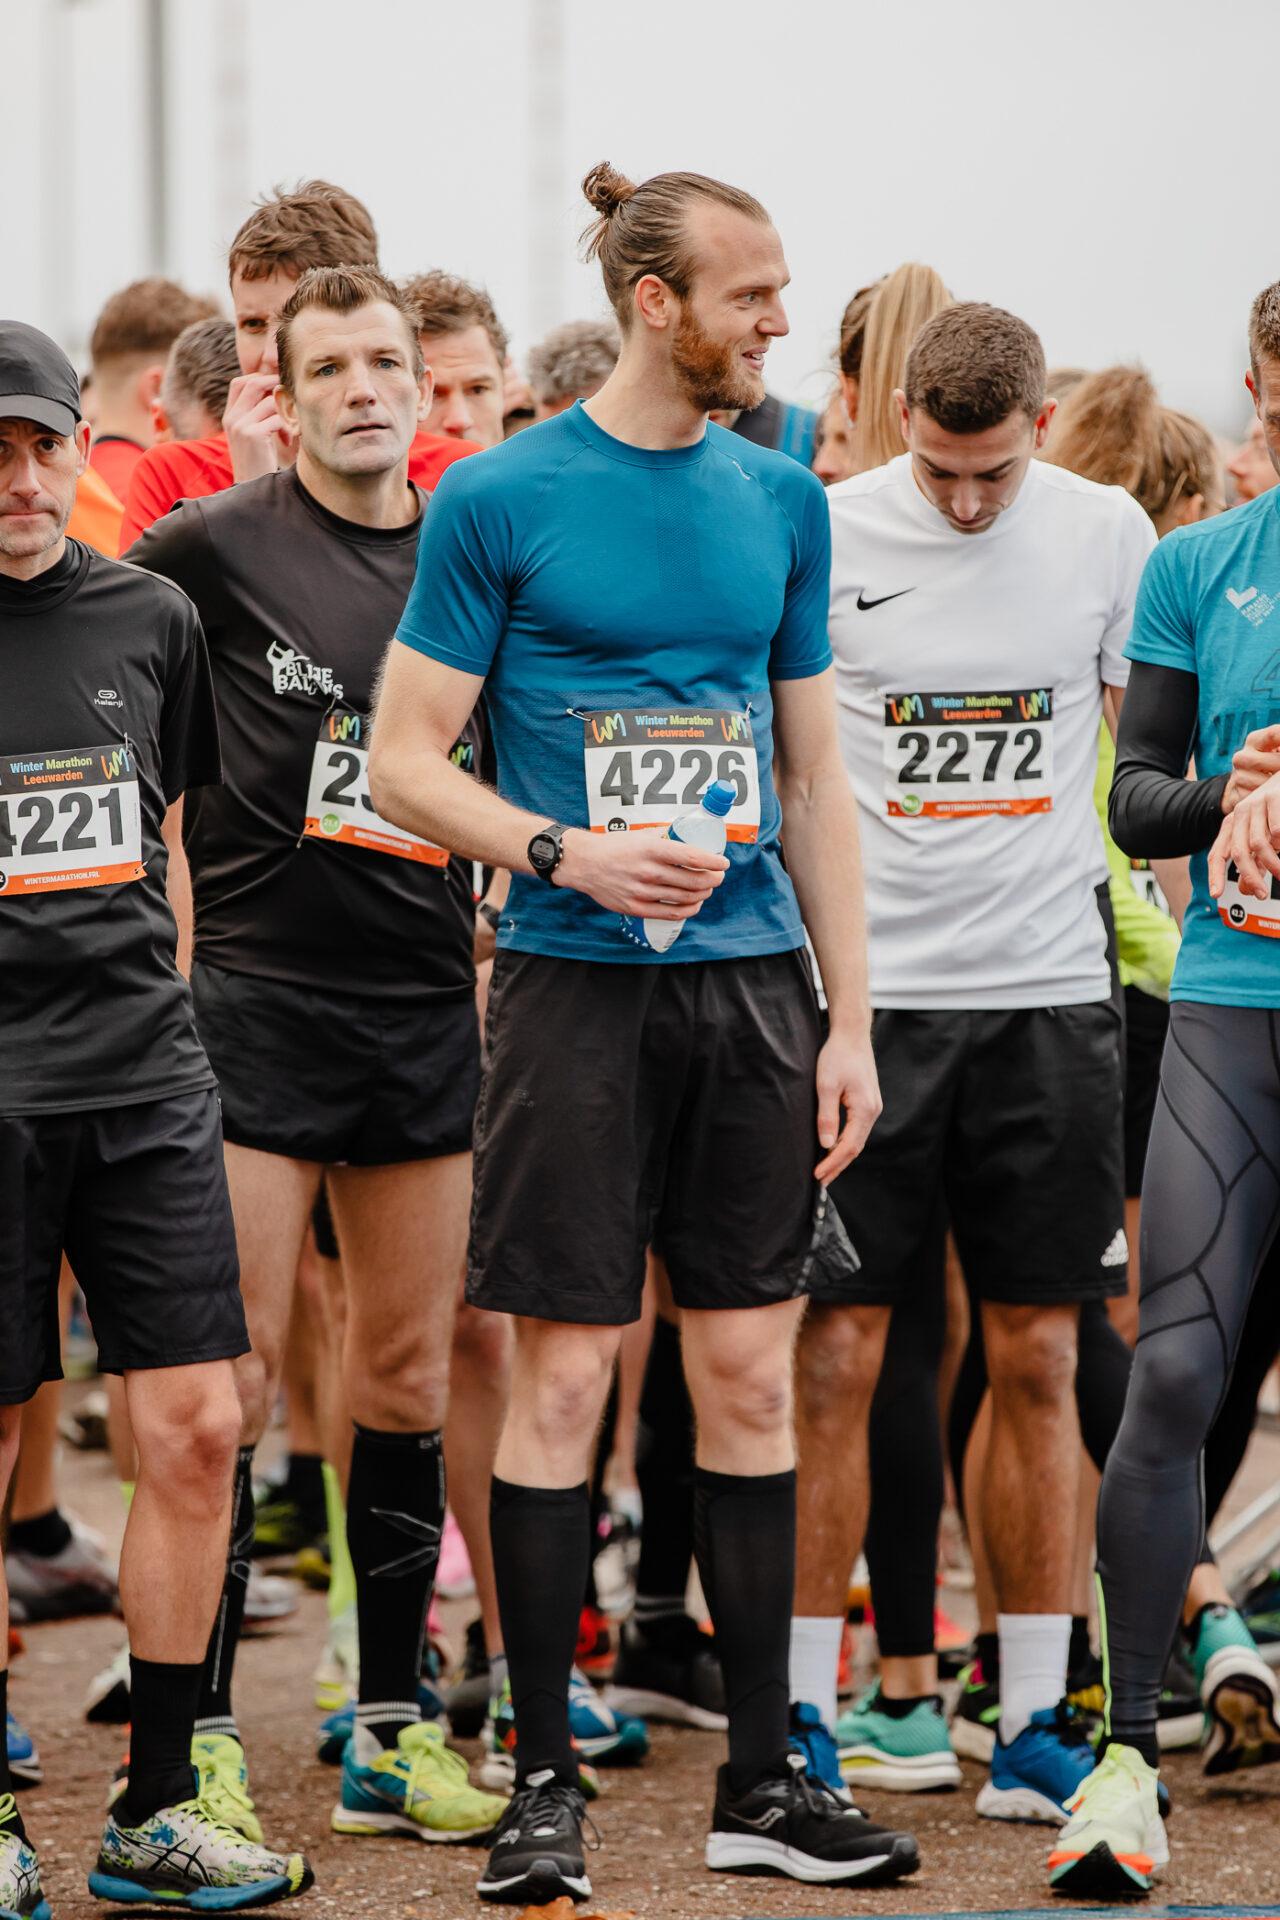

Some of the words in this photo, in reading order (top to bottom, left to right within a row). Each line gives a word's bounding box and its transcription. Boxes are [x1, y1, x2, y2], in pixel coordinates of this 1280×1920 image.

[931, 696, 965, 709] Winter
[965, 695, 1013, 708] Marathon
[634, 715, 668, 726] Winter
[669, 714, 714, 727] Marathon
[942, 708, 1002, 720] Leeuwarden
[647, 727, 705, 738] Leeuwarden
[898, 728, 1042, 783] 2272
[10, 761, 44, 774] Winter
[46, 756, 93, 770] Marathon
[23, 770, 84, 786] Leeuwarden
[321, 751, 377, 813] 2
[600, 749, 748, 807] 4226
[24, 871, 100, 886] WINTERMARATHON.FRL
